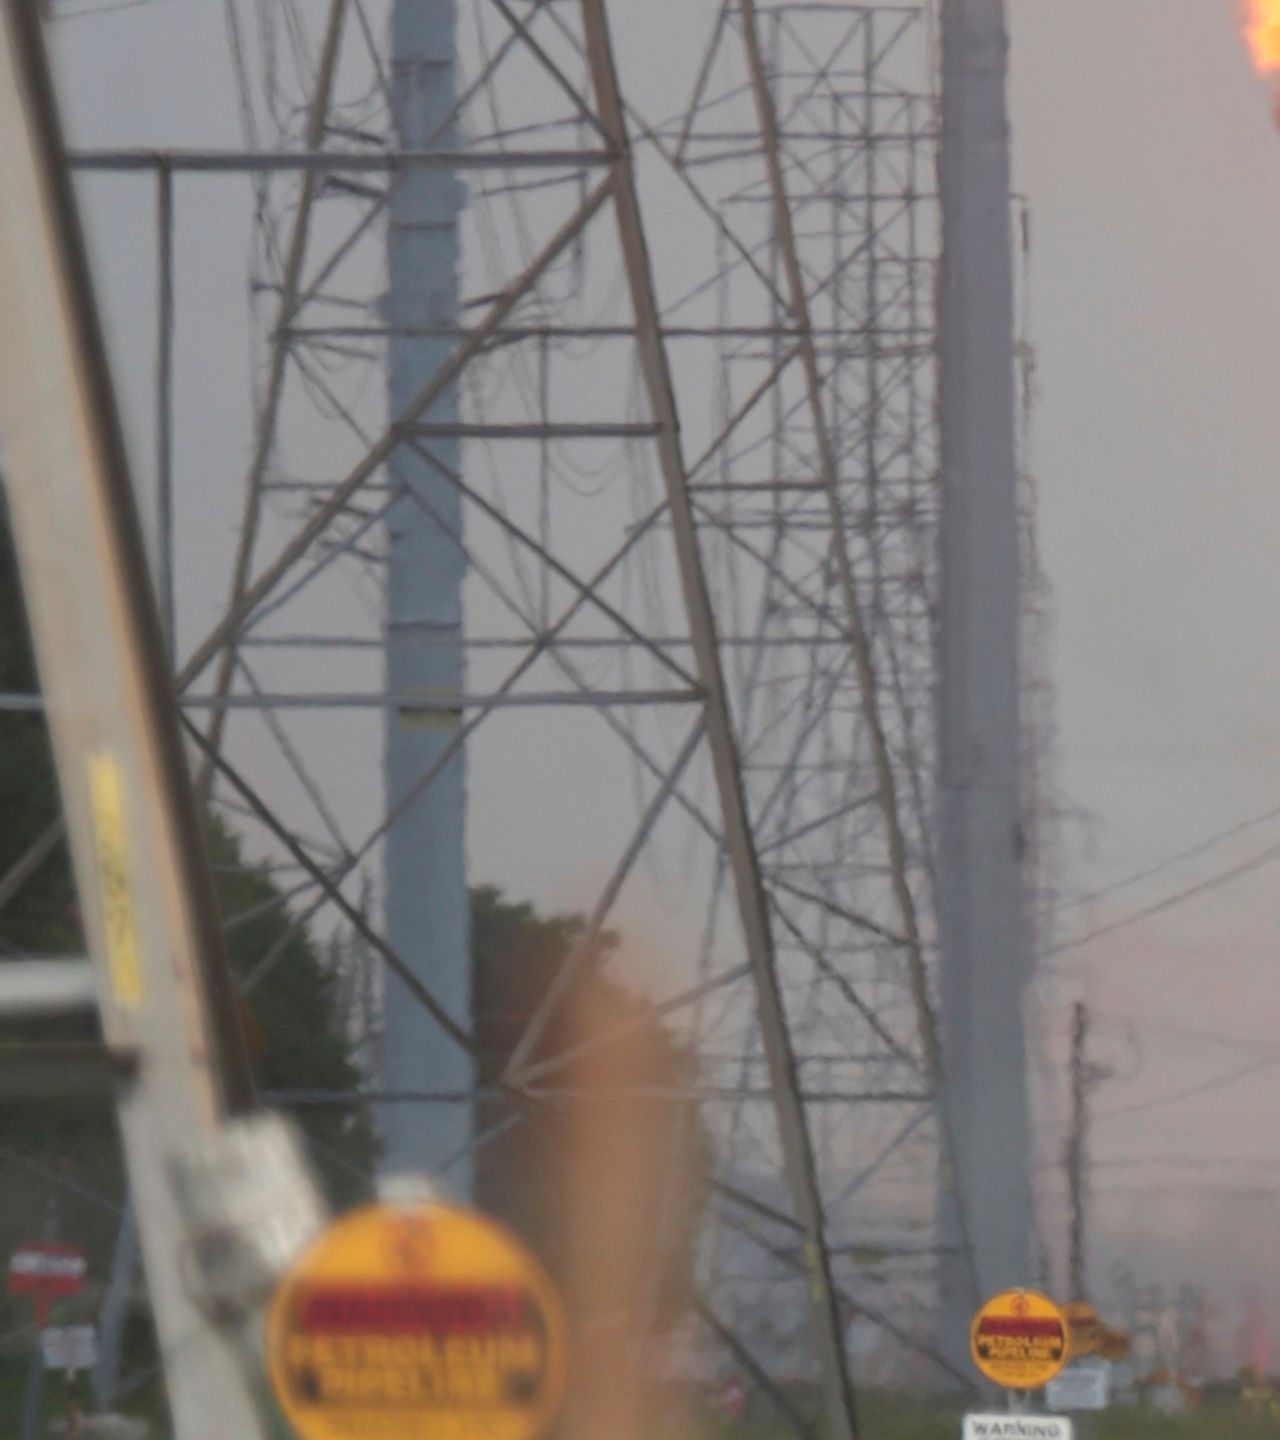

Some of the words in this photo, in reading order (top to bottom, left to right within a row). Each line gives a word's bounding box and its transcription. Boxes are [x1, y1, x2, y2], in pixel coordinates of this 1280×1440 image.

[287, 1334, 539, 1368] PETROLEUM
[977, 1335, 1061, 1349] PETROLEUM
[320, 1368, 503, 1402] PIPELINE
[972, 1421, 1061, 1438] WARNING
